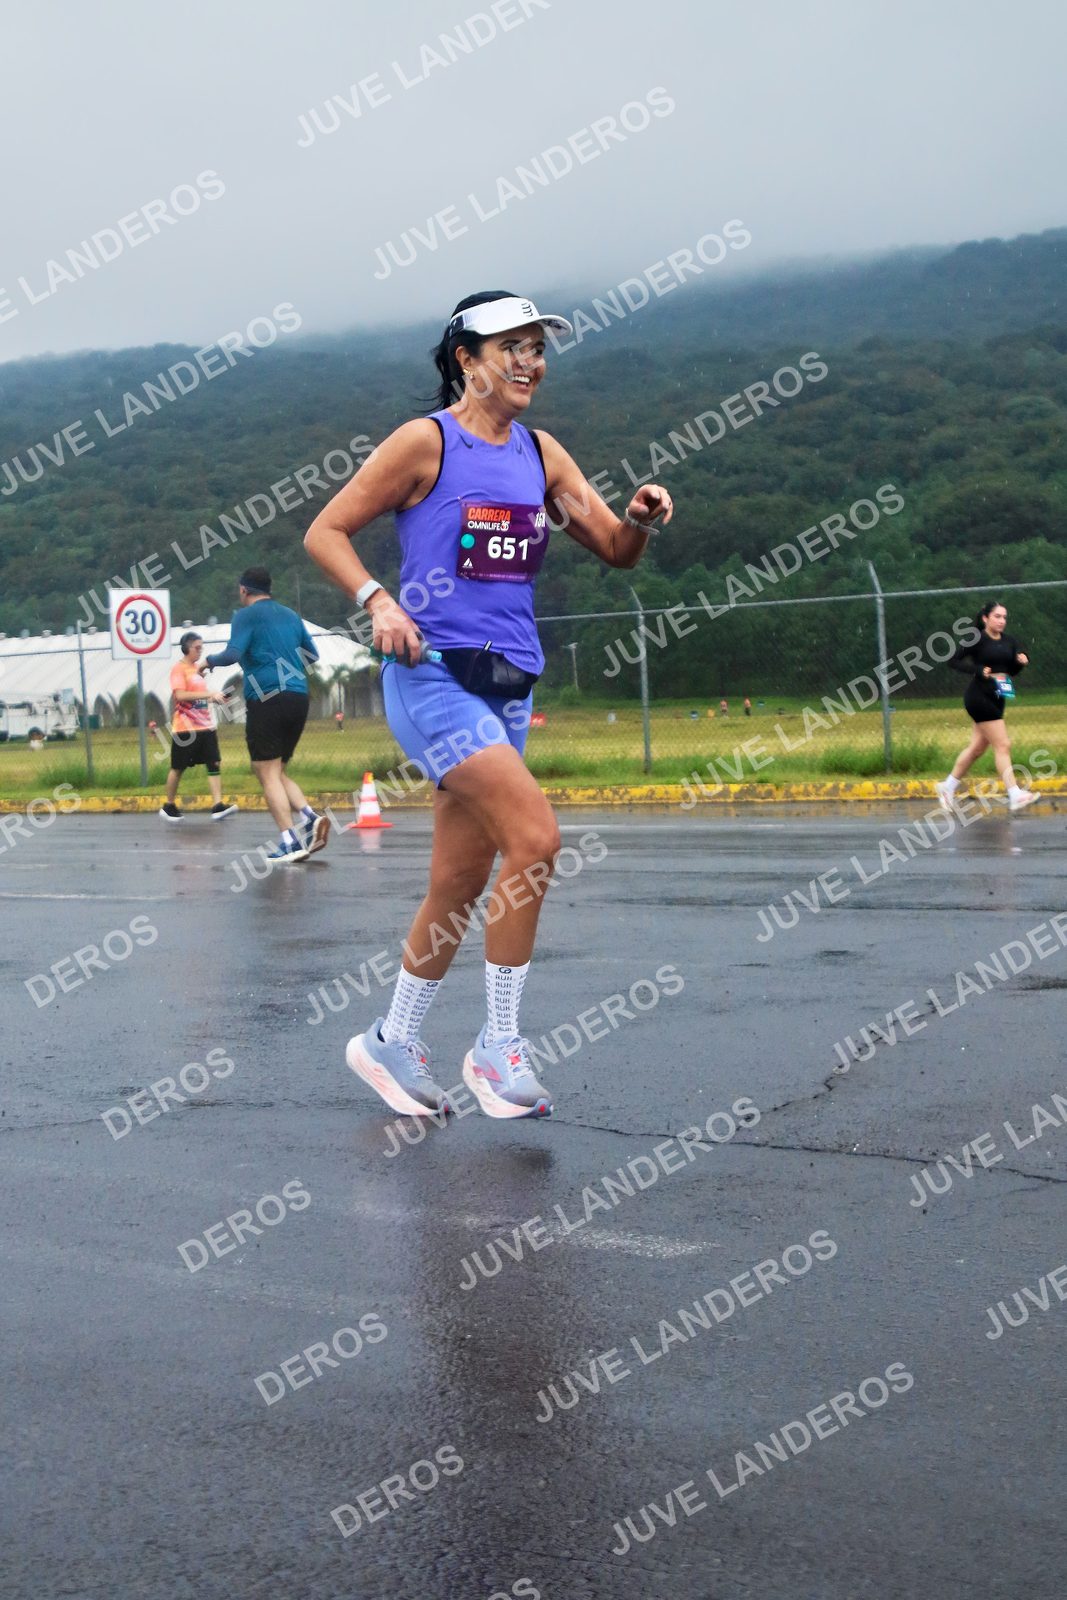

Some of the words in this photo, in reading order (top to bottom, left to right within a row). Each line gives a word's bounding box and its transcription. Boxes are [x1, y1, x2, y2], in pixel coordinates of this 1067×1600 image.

[467, 507, 511, 522] CARRERA
[488, 536, 529, 560] 651
[125, 609, 156, 635] 30
